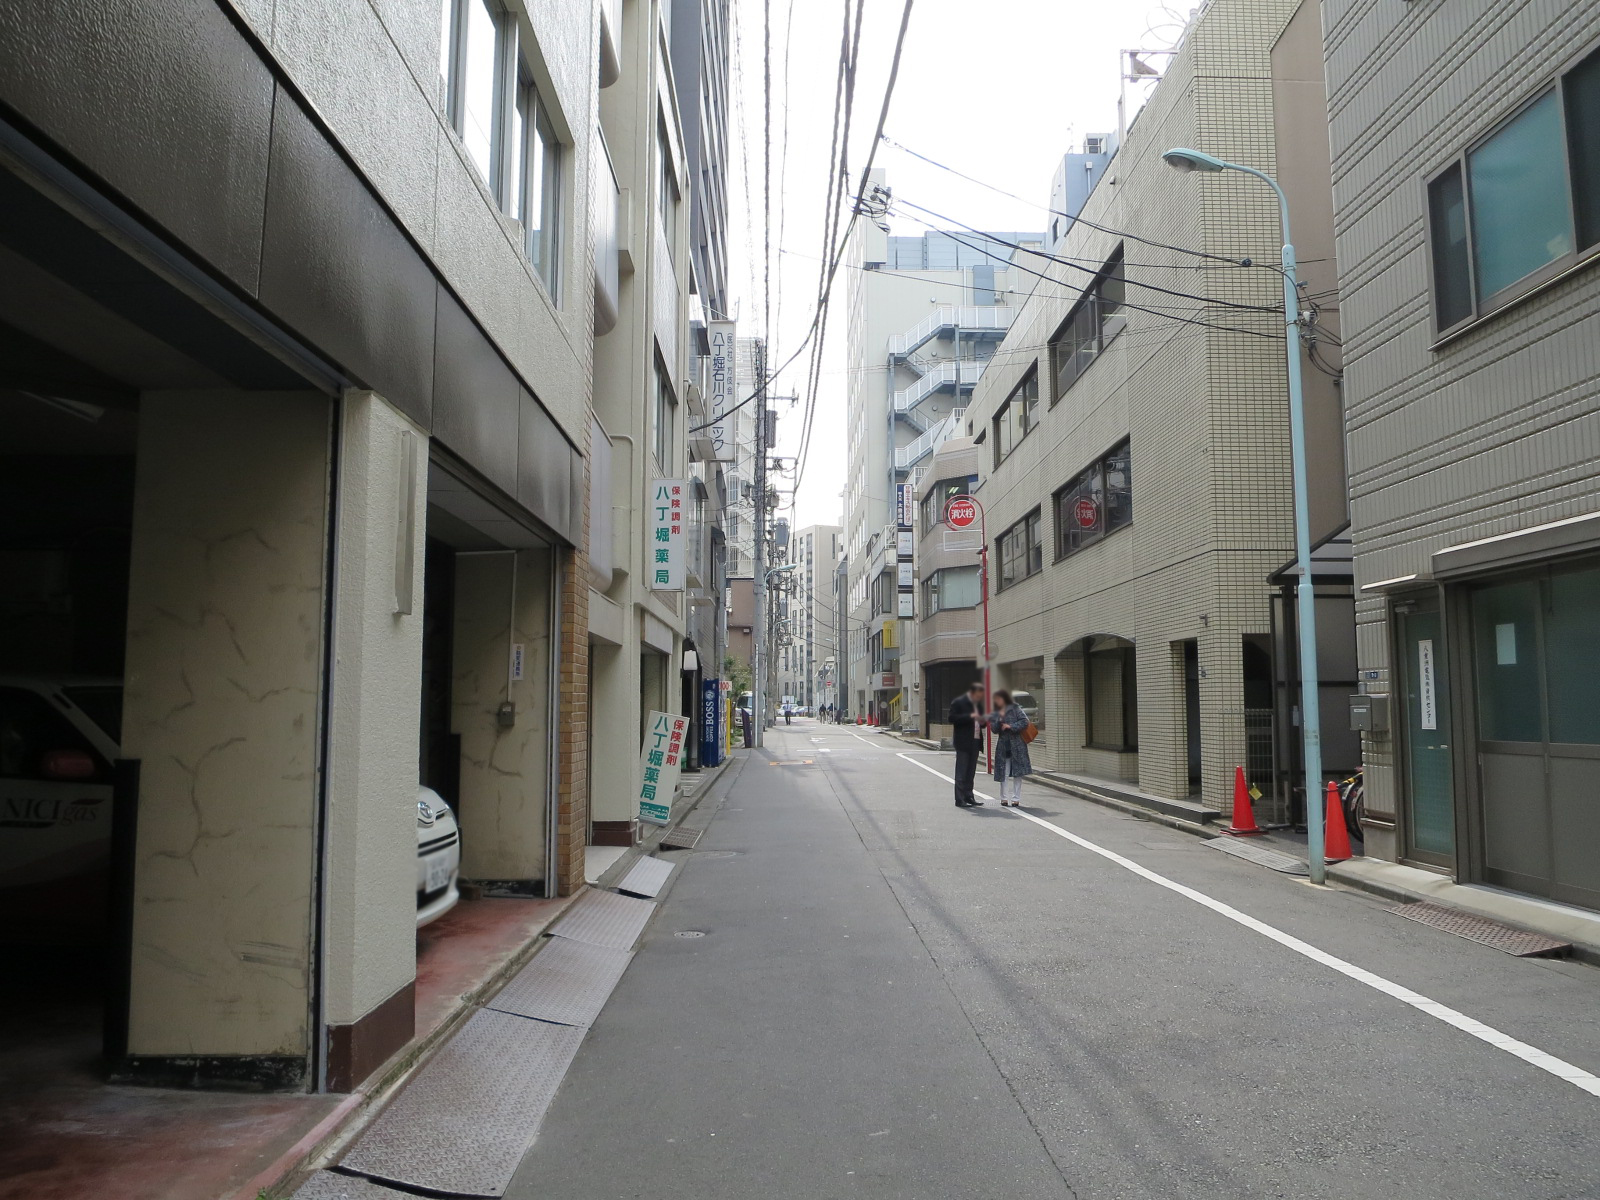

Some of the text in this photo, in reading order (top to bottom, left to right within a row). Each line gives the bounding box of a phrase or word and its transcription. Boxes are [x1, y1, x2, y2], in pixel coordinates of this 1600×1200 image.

[712, 332, 725, 452] 八丁堀石川クリニック
[655, 486, 670, 584] 八丁堀薬局
[671, 486, 681, 535] 保険調剤
[951, 508, 974, 520] 消火栓
[706, 701, 714, 725] BOSS
[640, 716, 668, 800] 八丁堀薬局
[665, 719, 684, 766] 保険調剤
